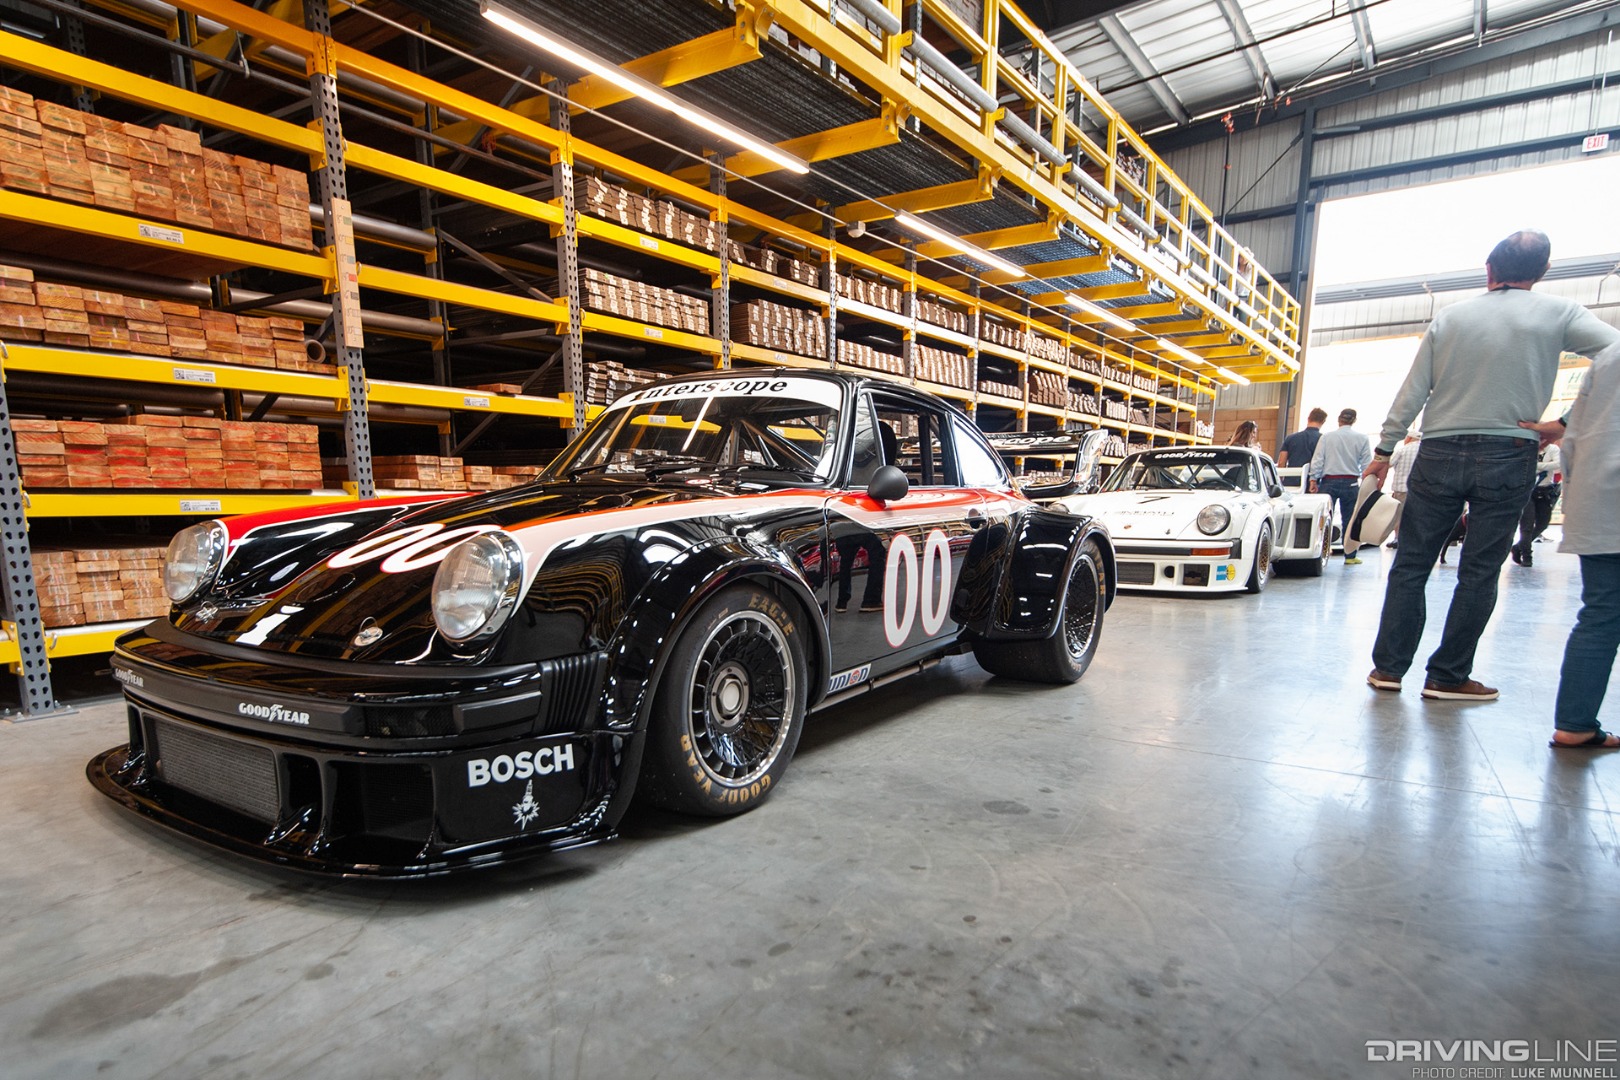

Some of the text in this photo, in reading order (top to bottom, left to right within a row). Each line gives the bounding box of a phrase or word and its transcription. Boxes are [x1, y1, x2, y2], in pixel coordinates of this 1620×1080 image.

[1587, 136, 1605, 149] EXIT
[1154, 450, 1217, 460] GOODYEAR
[326, 522, 502, 574] 00
[883, 527, 952, 648] 00
[114, 668, 144, 688] GOODYEAR
[238, 703, 310, 725] GOODYEAR
[467, 743, 575, 788] BOSCH
